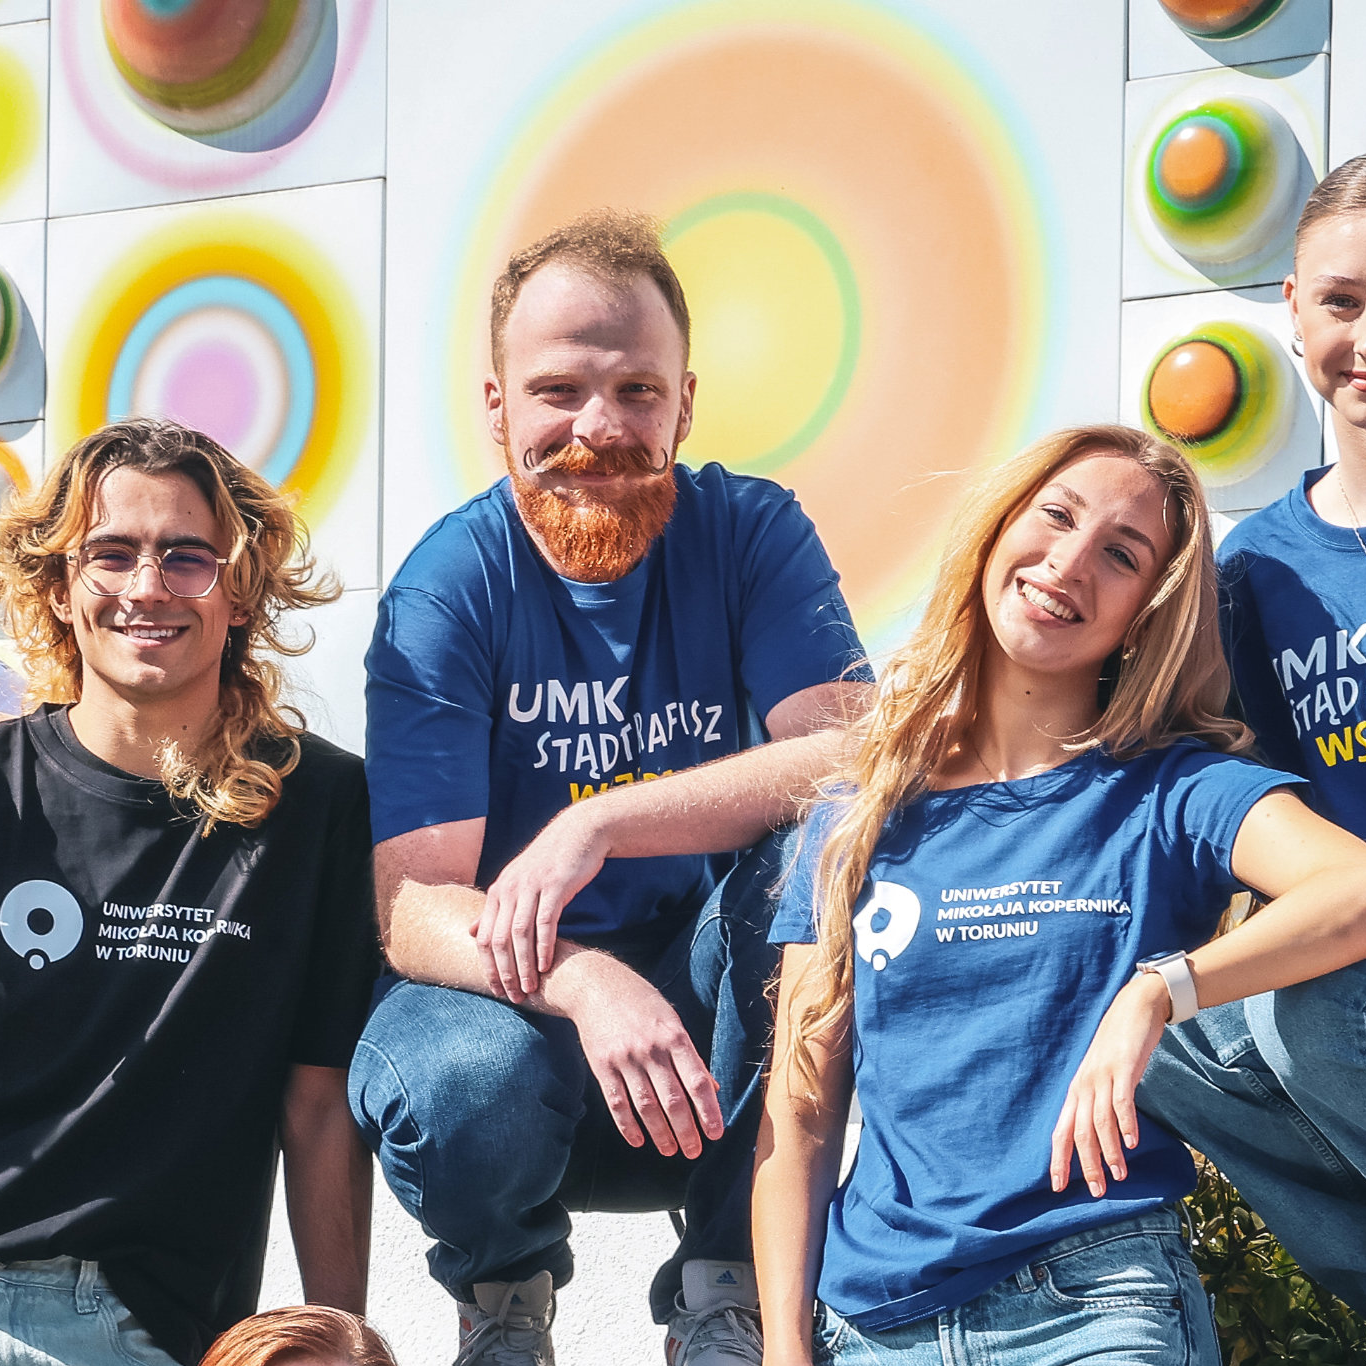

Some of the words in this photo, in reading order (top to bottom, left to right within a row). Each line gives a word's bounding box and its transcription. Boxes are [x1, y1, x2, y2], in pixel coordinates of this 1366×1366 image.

[533, 731, 620, 779] STĄD
[940, 881, 1063, 903] UNIWERSYTET
[102, 901, 215, 923] UNIWERSYTET
[937, 902, 1026, 921] MIKOŁAJA
[1028, 899, 1132, 914] KOPERNIKA
[98, 923, 179, 941] MIKOŁAJA
[935, 927, 955, 943] W
[958, 921, 1039, 941] TORUNIU
[95, 944, 111, 960] W
[115, 943, 191, 963] TORUNIU
